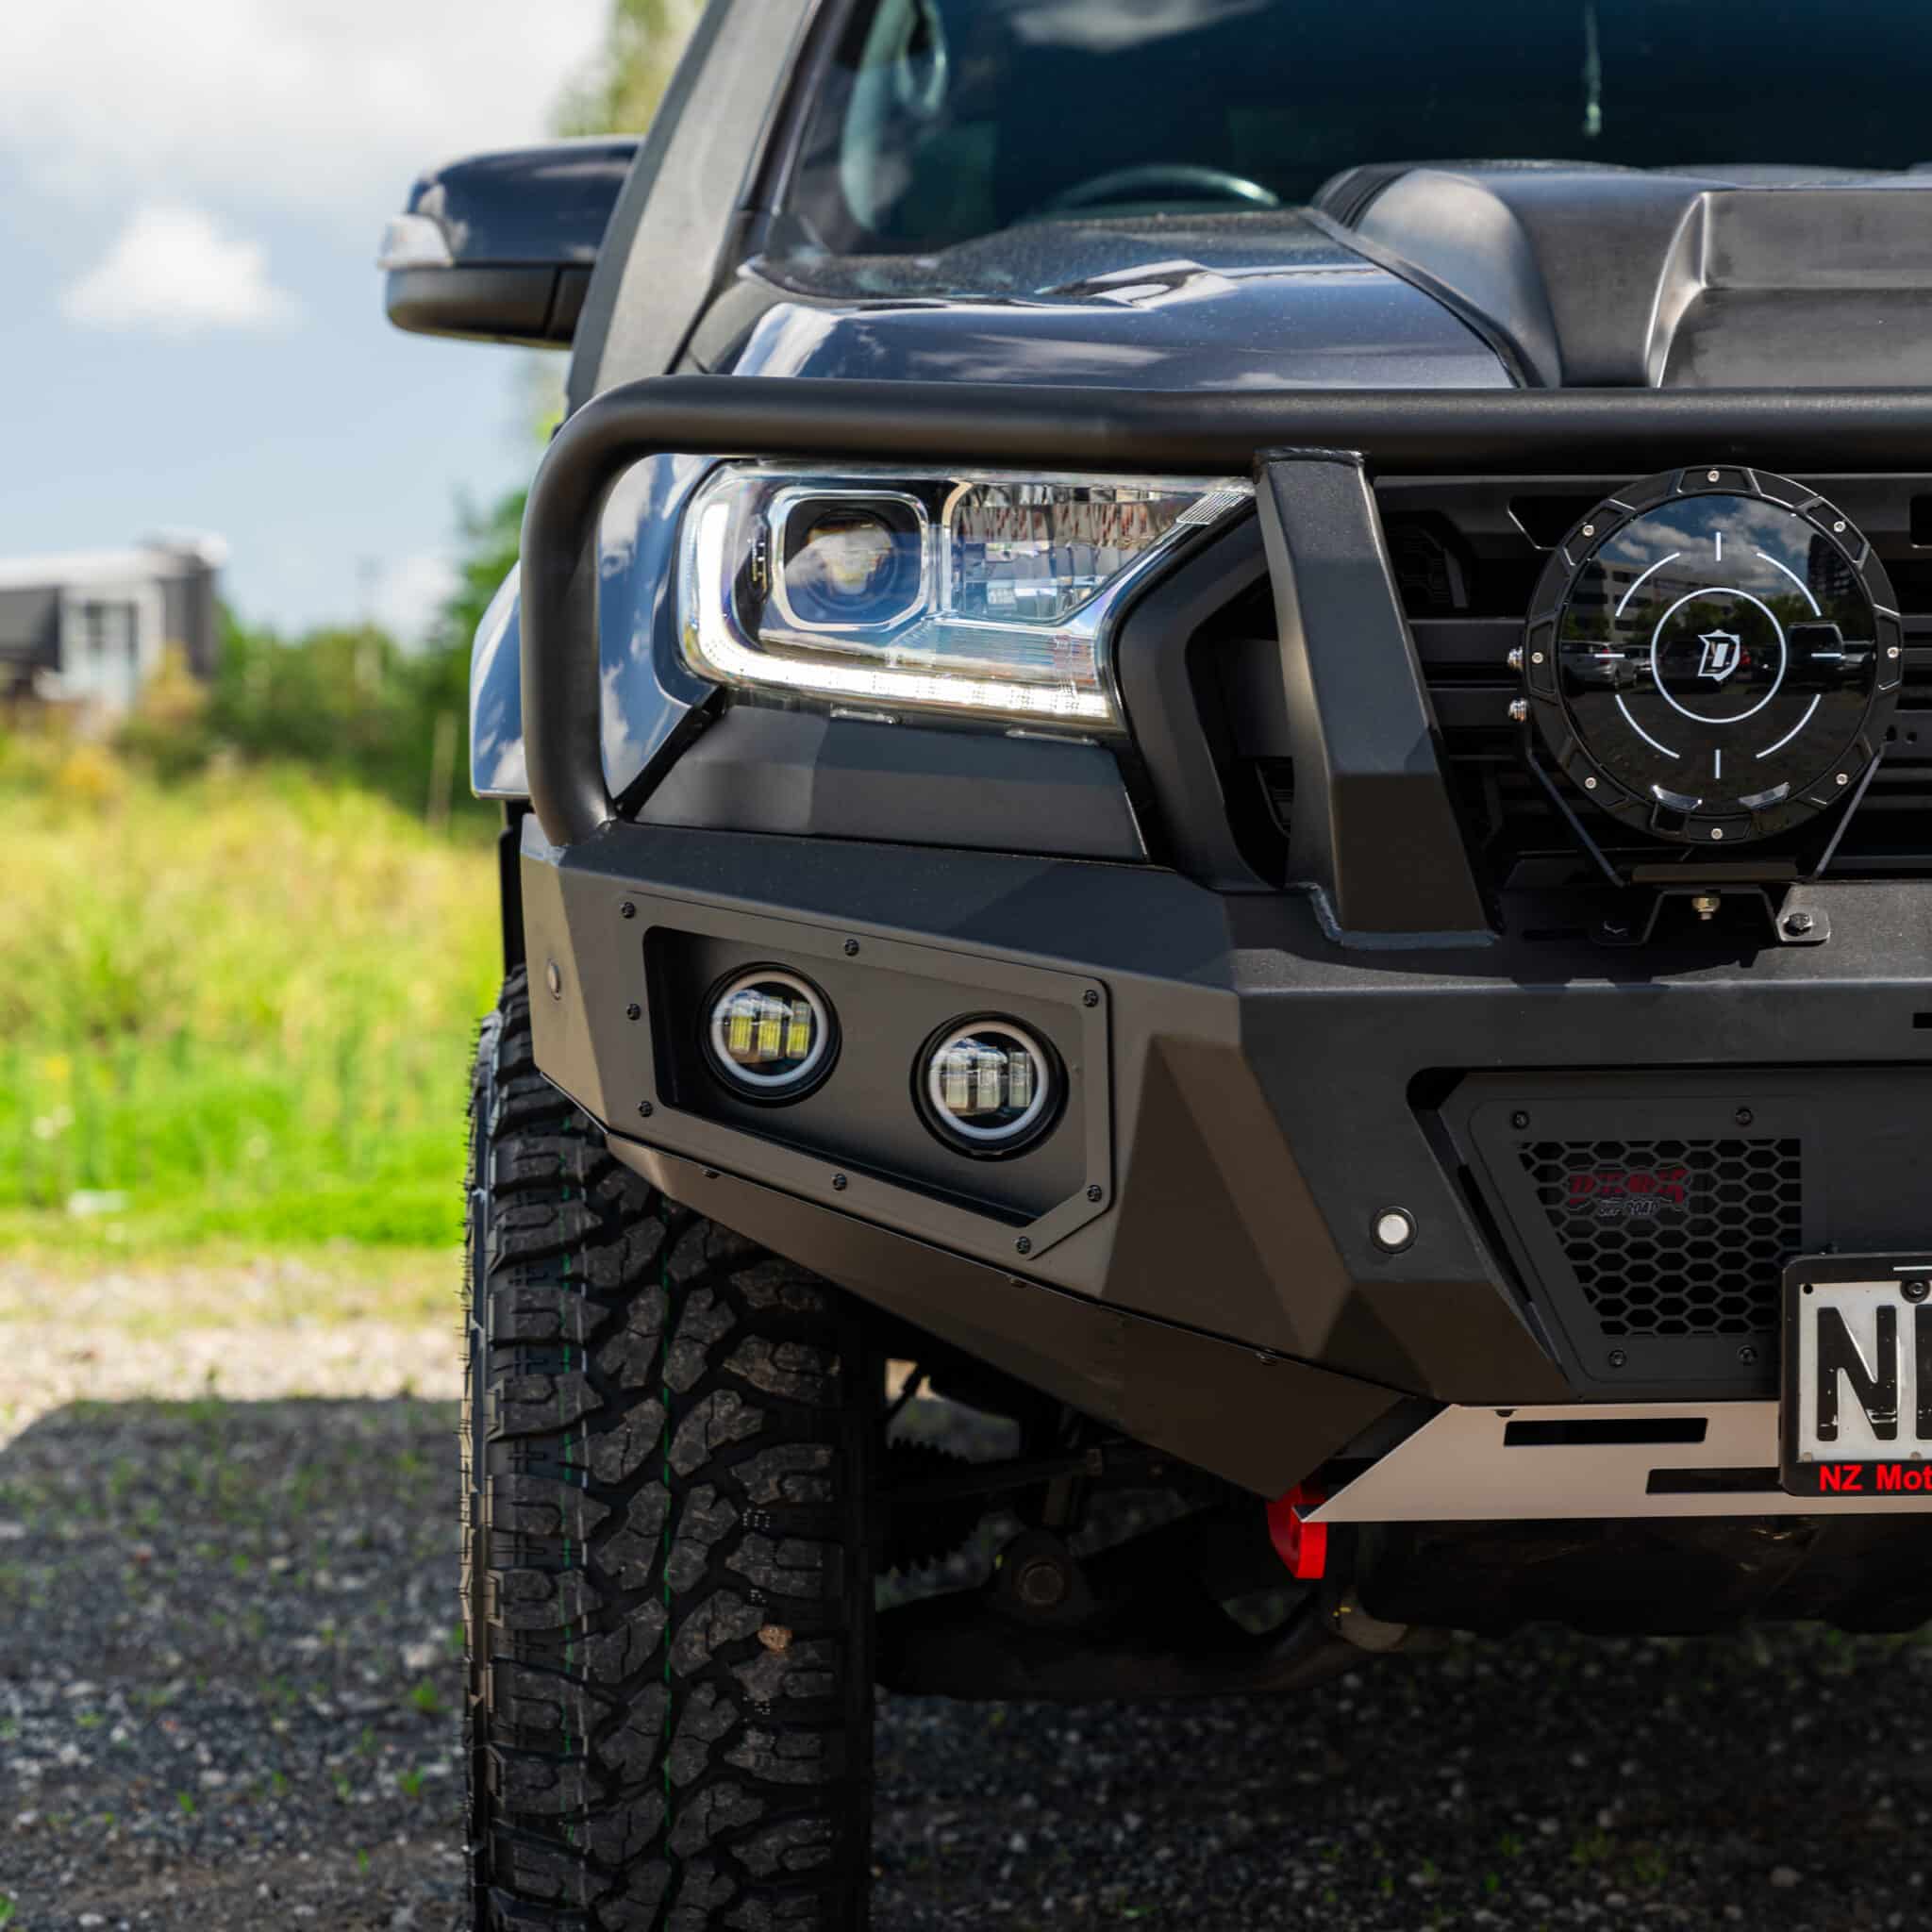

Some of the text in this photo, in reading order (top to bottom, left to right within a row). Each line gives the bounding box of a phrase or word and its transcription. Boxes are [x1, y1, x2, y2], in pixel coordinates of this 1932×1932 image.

[1817, 1304, 1932, 1441] N
[1819, 1464, 1932, 1491] NZ Mot
